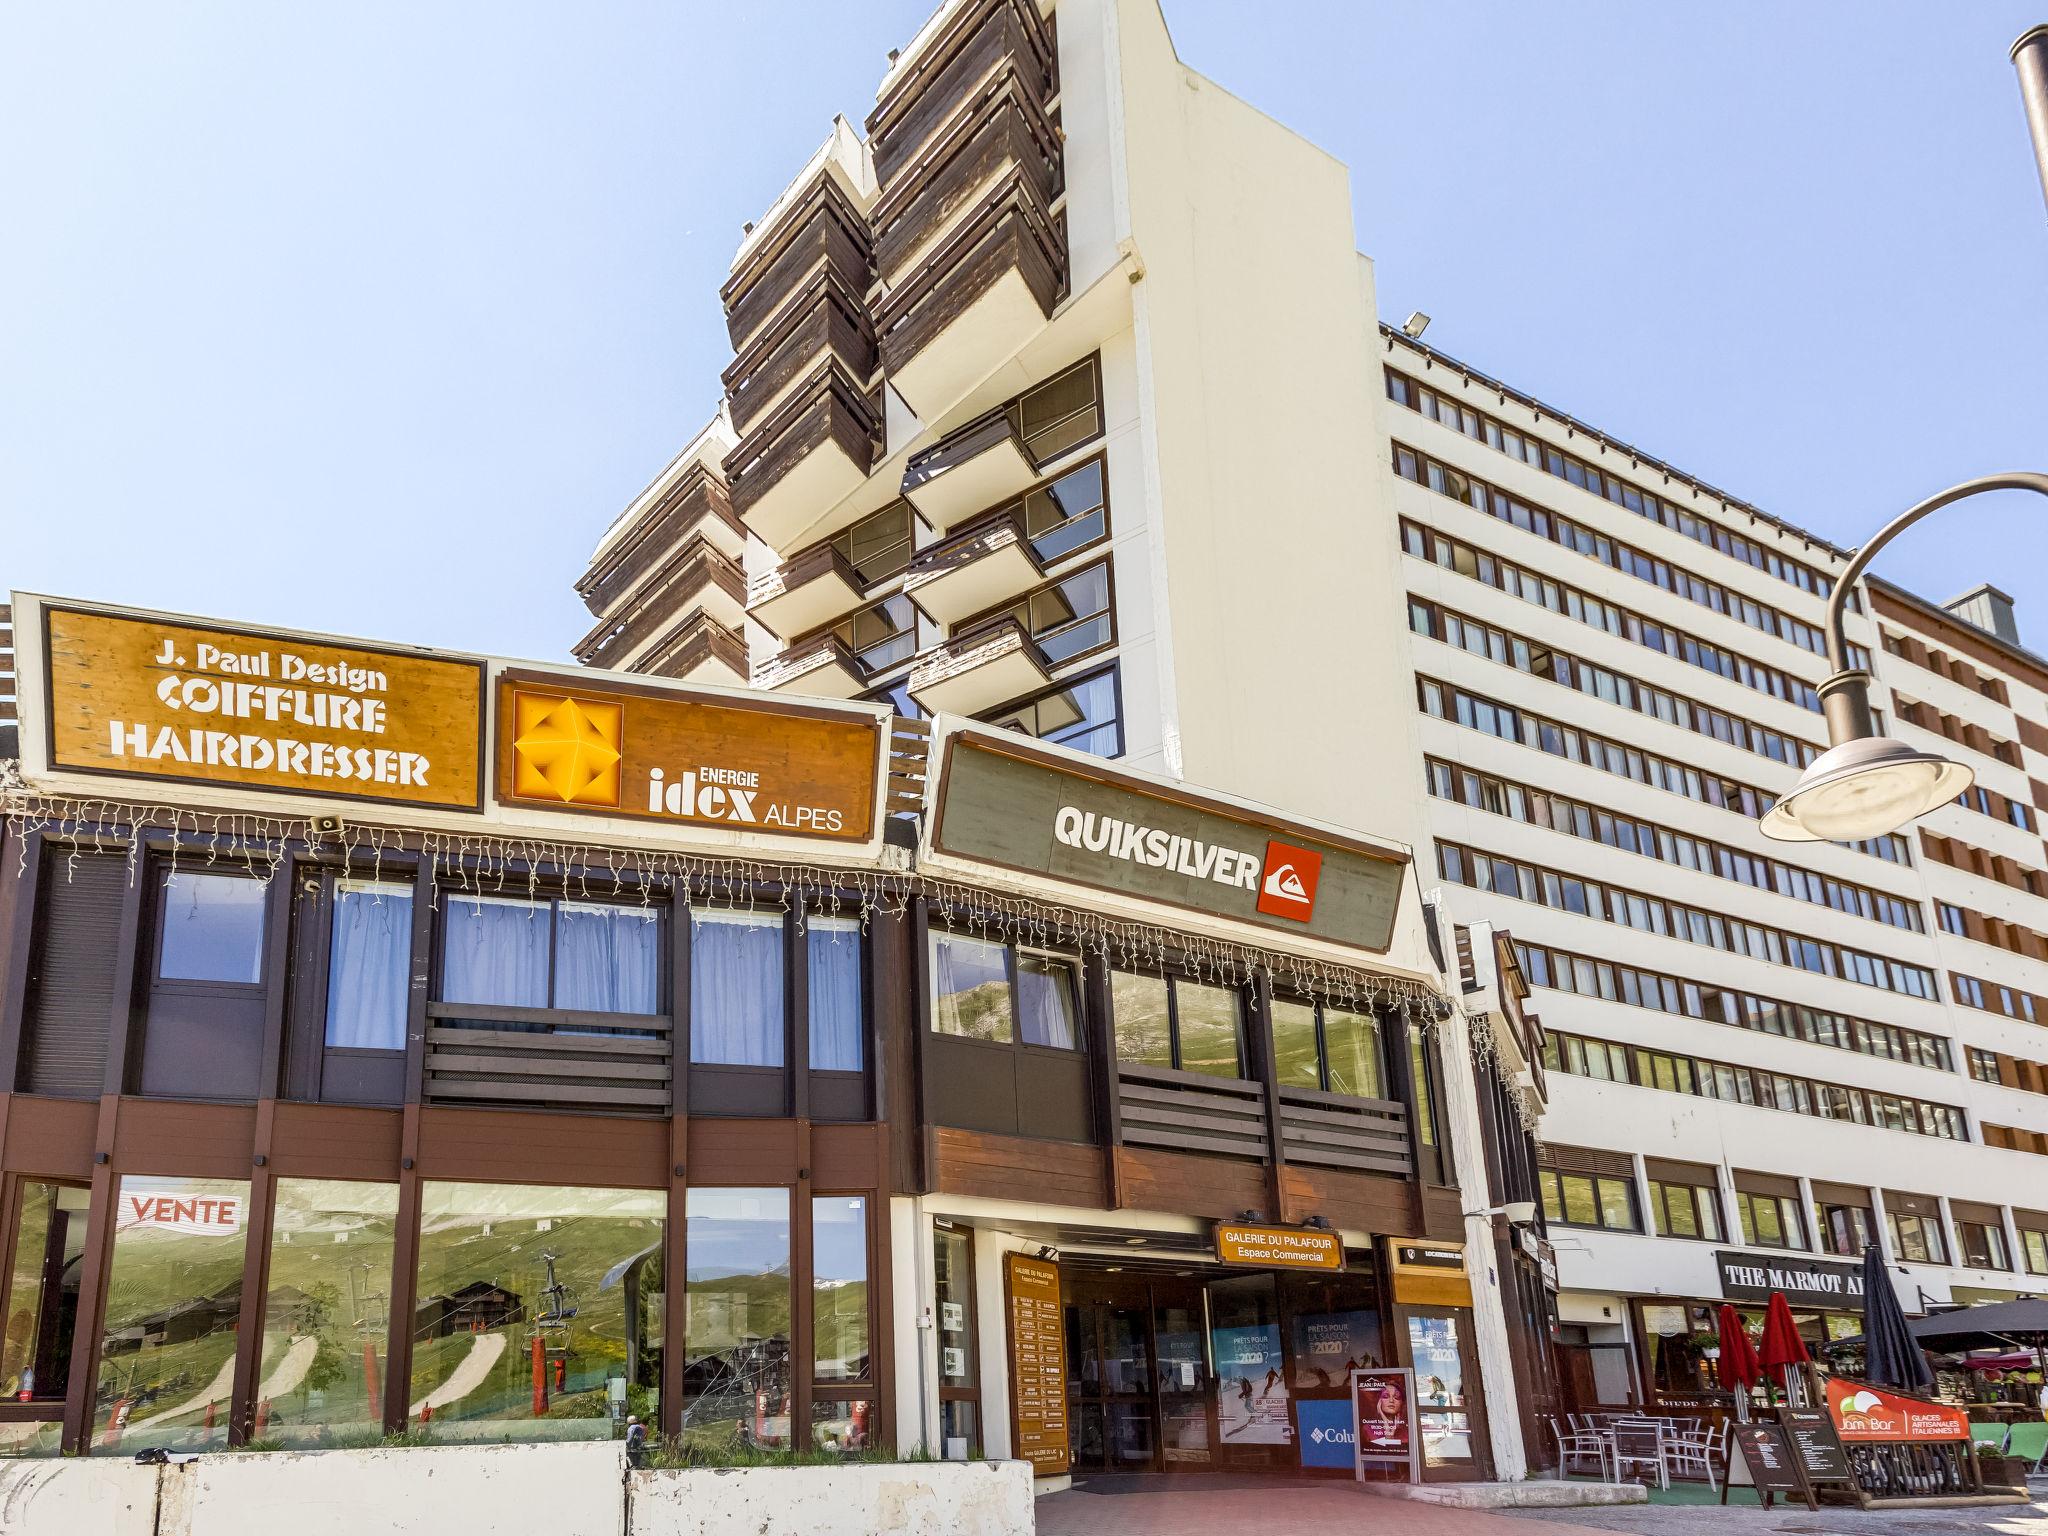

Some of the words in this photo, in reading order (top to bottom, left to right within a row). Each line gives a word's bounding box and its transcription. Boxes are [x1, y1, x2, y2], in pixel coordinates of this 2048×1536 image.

[155, 639, 186, 666] J.
[197, 642, 270, 678] Paul
[281, 652, 388, 694] Design
[156, 674, 387, 734] COIFFURE
[109, 719, 431, 787] HAIRDRESSER
[700, 766, 759, 788] ENERGIE
[649, 767, 758, 823] idex
[763, 803, 843, 832] ALPES
[1054, 805, 1260, 891] QUIKSILVER
[131, 1197, 236, 1225] VENTE
[1225, 1232, 1266, 1245] GALERIE
[1268, 1235, 1282, 1245] DU
[1284, 1237, 1332, 1249] PALAFOUR
[1238, 1247, 1270, 1259] Espace
[1272, 1249, 1324, 1262] Commercial
[1725, 1265, 1766, 1287] THE
[1767, 1268, 1842, 1294] MARMOT
[1251, 1335, 1268, 1343] POUR
[1239, 1352, 1263, 1364] 2020
[1430, 1348, 1456, 1361] 2020
[1839, 1418, 1865, 1430] Jam
[1871, 1418, 1896, 1430] Bar
[1324, 1428, 1355, 1443] Colu
